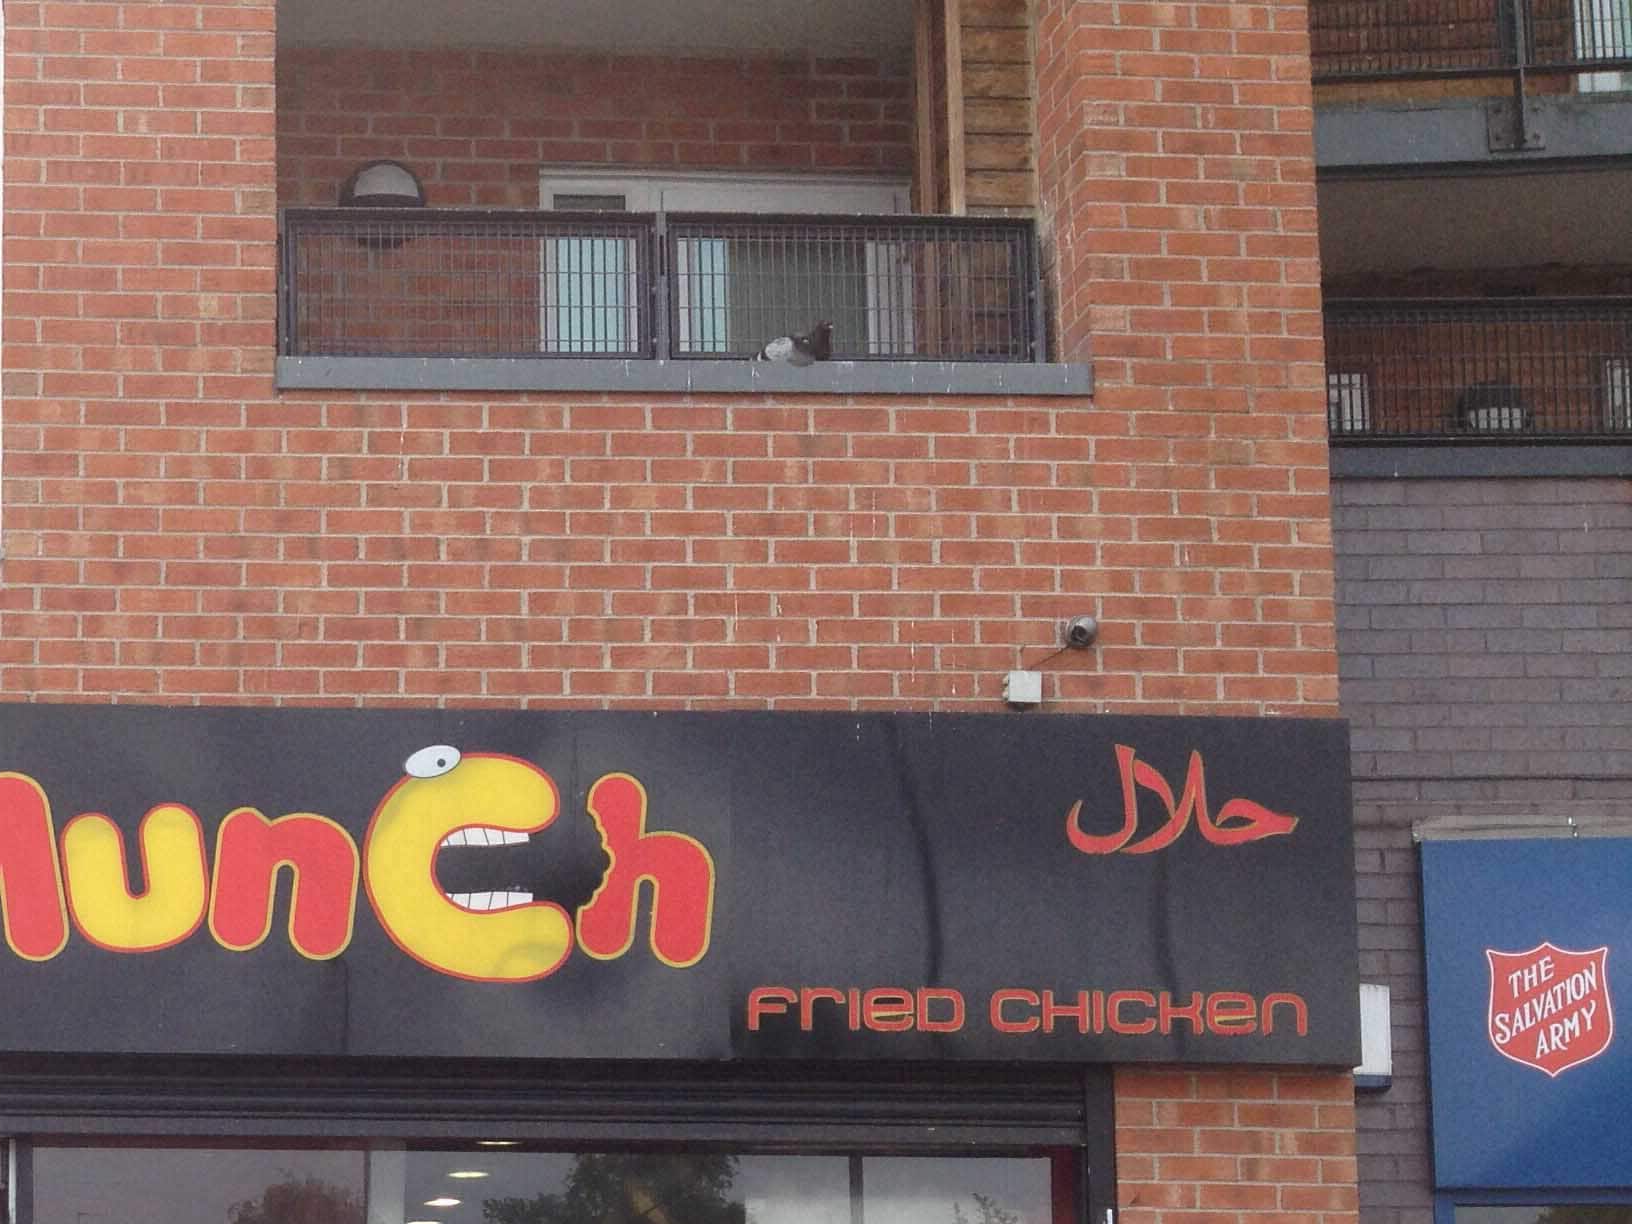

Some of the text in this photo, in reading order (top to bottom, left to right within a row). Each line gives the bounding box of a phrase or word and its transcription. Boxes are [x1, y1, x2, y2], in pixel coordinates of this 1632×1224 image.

[1067, 743, 1299, 855] حلال
[1494, 961, 1598, 1045] SALVATION
[1508, 955, 1555, 999] THE
[1536, 999, 1596, 1060] ARMY
